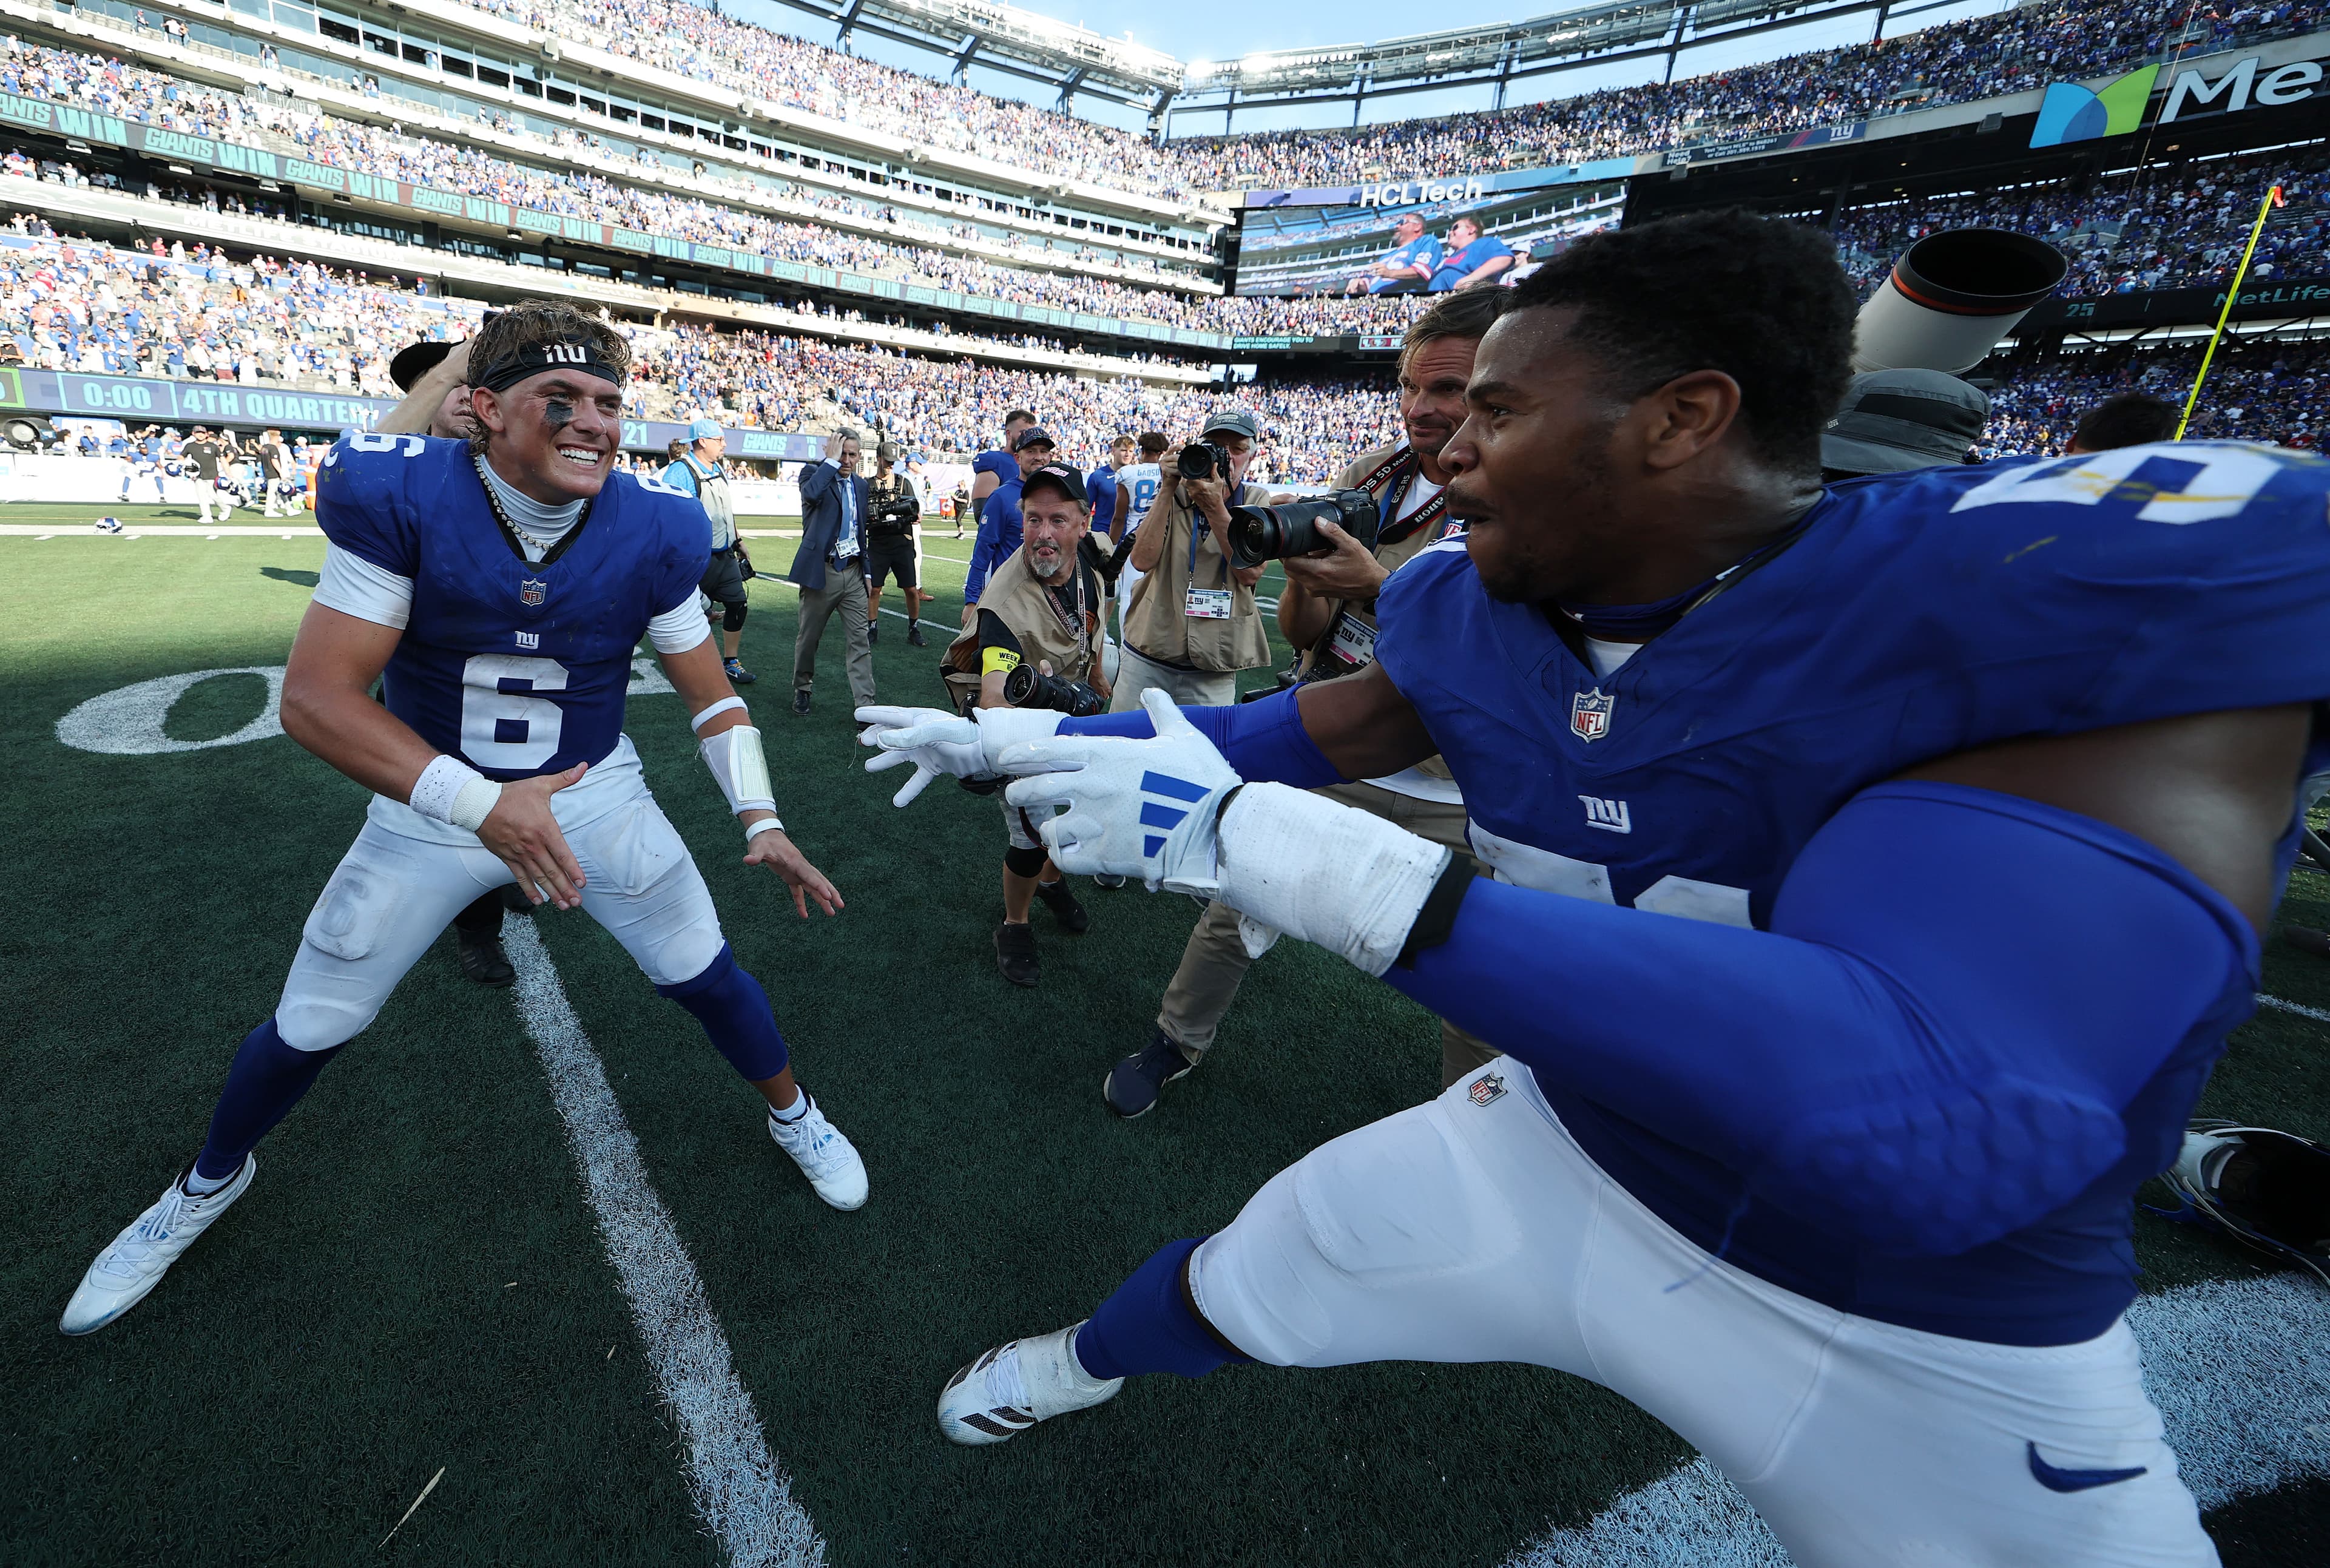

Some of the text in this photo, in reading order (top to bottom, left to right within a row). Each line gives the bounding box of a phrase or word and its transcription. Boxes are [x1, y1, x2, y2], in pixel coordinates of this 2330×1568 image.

[2158, 57, 2322, 124] Me
[55, 106, 127, 146] WIN
[1830, 124, 1854, 141] ny
[145, 127, 277, 178] GIANTS WIN
[285, 158, 399, 203] GIANTS WIN
[411, 186, 510, 226] GIANTS WIN
[516, 209, 603, 243] GIANTS WIN
[612, 228, 689, 260] GIANTS WIN
[694, 244, 765, 274] GIANTS WIN
[772, 260, 837, 288] GIANTS WIN
[840, 273, 900, 299] GIANTS WIN
[908, 286, 962, 309] GIANTS WIN
[965, 297, 1017, 319] GIANTS WIN
[2065, 302, 2096, 317] 25
[1023, 305, 1072, 326] GIANTS WIN
[1099, 318, 1122, 334] WIN
[83, 382, 152, 410] 0:00
[183, 388, 365, 425] 4TH QUARTER
[624, 422, 647, 446] 21
[743, 433, 787, 451] GIANTS
[808, 445, 816, 459] 0
[1376, 453, 1411, 479] 5D Mark
[1133, 479, 1155, 513] 8
[1391, 475, 1411, 504] EOS R5
[1414, 495, 1445, 524] anon
[524, 592, 541, 603] NFL
[515, 631, 539, 649] ny
[1340, 626, 1356, 643] ny
[999, 652, 1018, 663] WEEK
[461, 653, 569, 769] 6
[1576, 712, 1602, 733] NFL
[1577, 795, 1632, 834] ny
[1471, 1080, 1491, 1101] NFL
